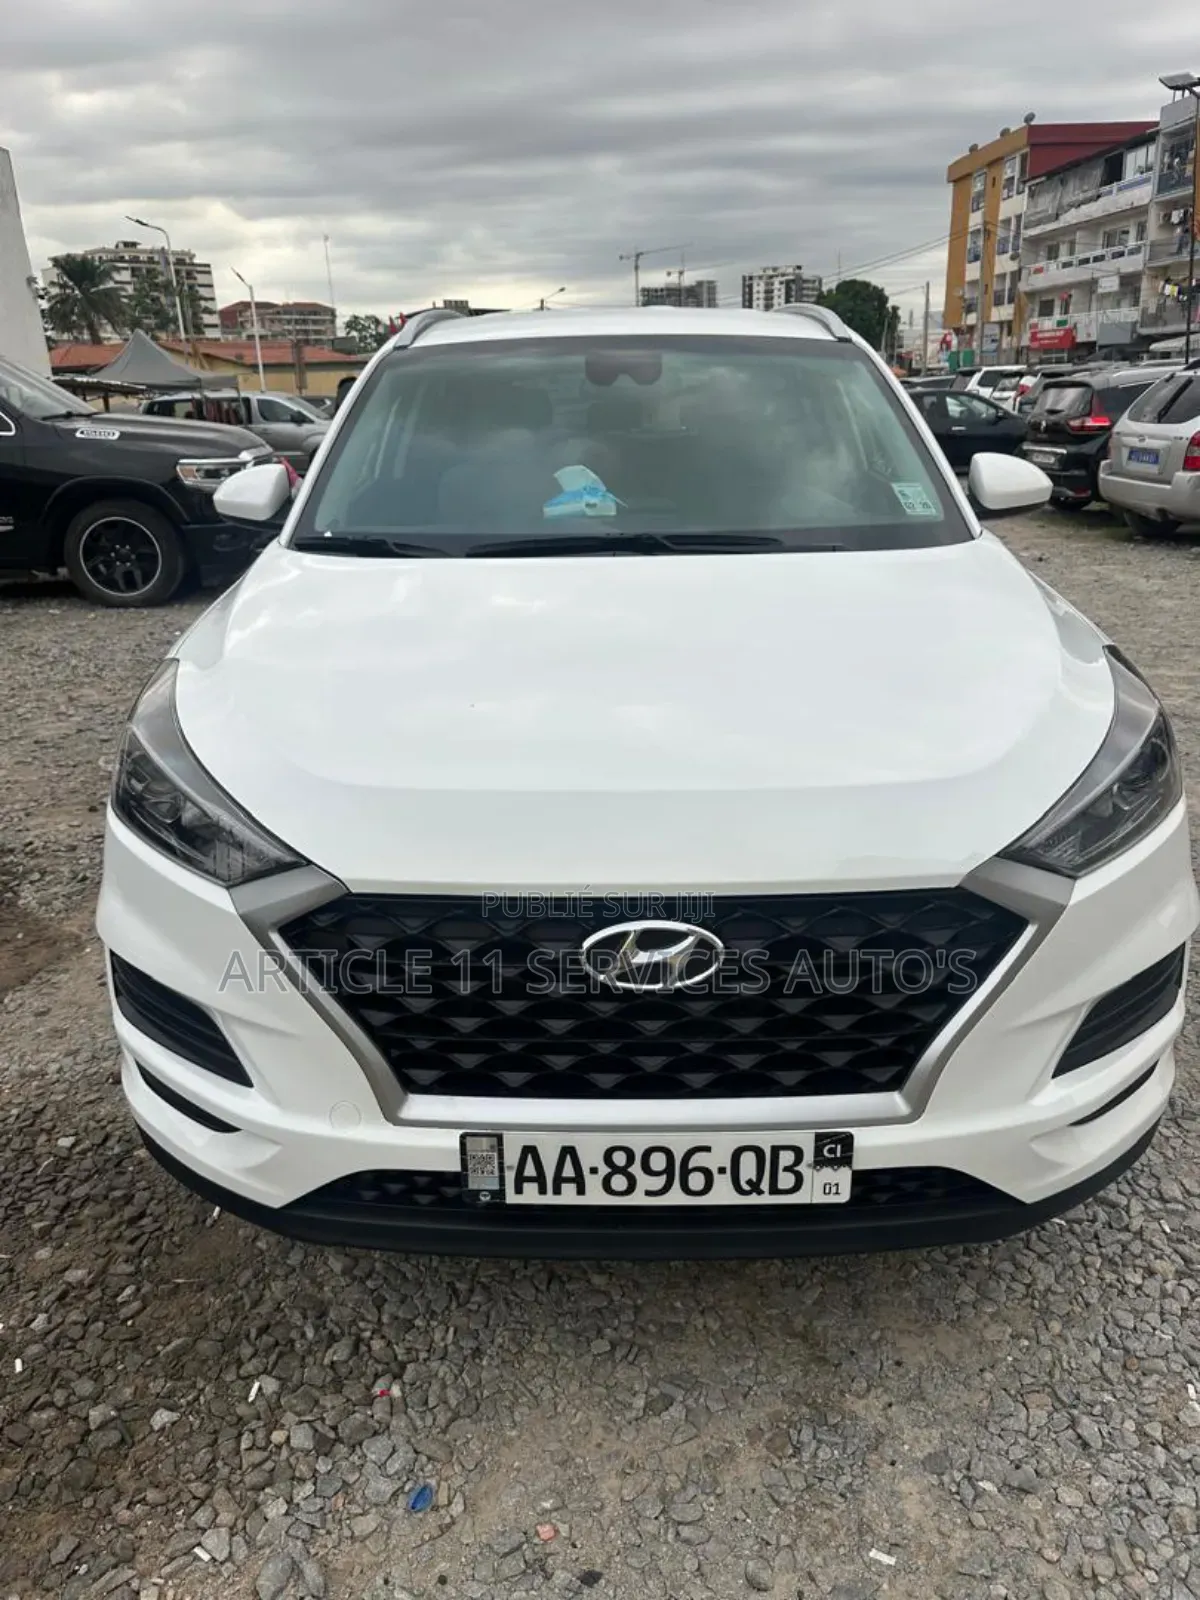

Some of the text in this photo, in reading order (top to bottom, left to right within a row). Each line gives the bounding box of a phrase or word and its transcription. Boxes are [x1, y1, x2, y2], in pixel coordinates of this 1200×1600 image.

[823, 1144, 841, 1157] CI
[513, 1145, 804, 1197] AA-896-QB
[823, 1182, 841, 1196] 01
